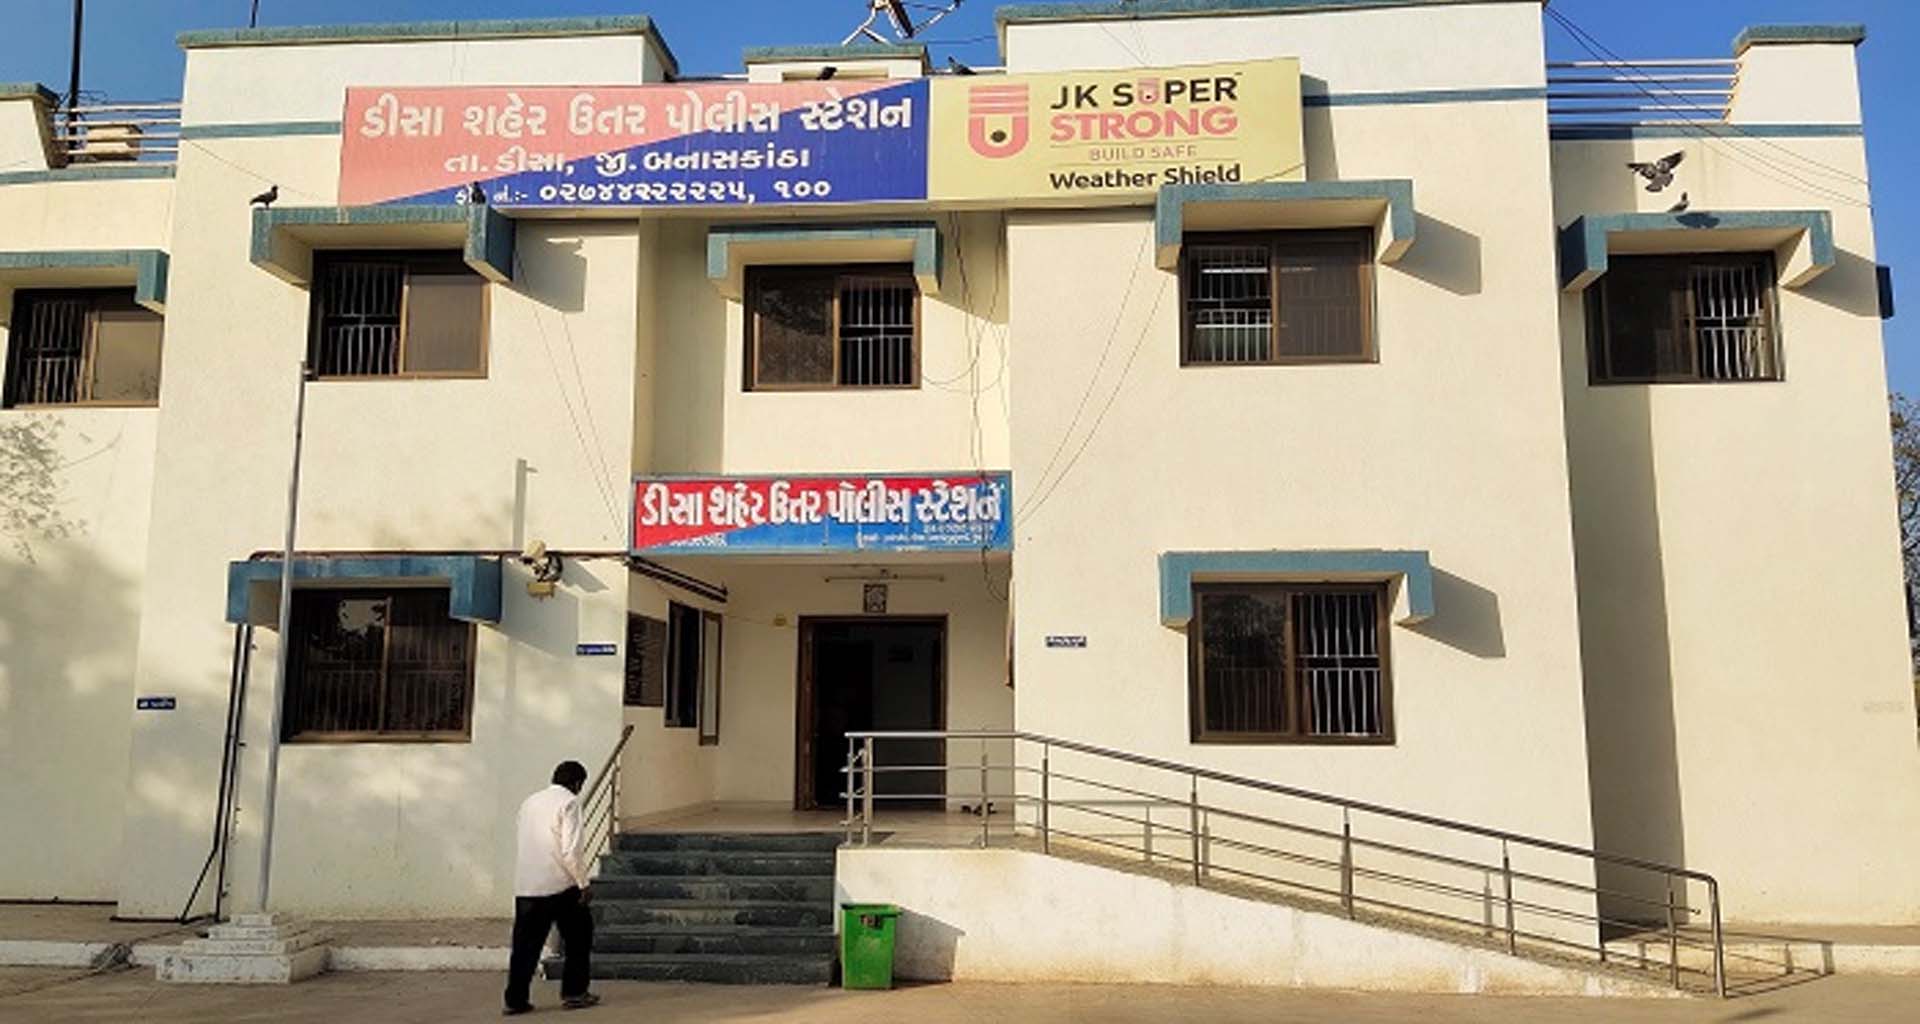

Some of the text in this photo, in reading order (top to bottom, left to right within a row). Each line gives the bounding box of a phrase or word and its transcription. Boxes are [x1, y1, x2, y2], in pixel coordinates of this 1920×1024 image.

[1050, 77, 1238, 110] JK SUPER
[360, 86, 912, 139] ડીસા શહેર ઉતર પોલીસ સ્ટેશન
[1050, 106, 1238, 141] STRONG
[444, 153, 488, 173] તા.
[495, 145, 575, 176] ડીસા,
[643, 142, 810, 171] બનાસકાંઠા
[1089, 145, 1198, 161] BUILD SAFE
[773, 180, 831, 199] ૧૦૦
[1050, 163, 1241, 189] Weather Shield
[641, 482, 703, 526] ડીસા
[707, 482, 766, 528] શહેર
[826, 480, 911, 524] પોલીસ
